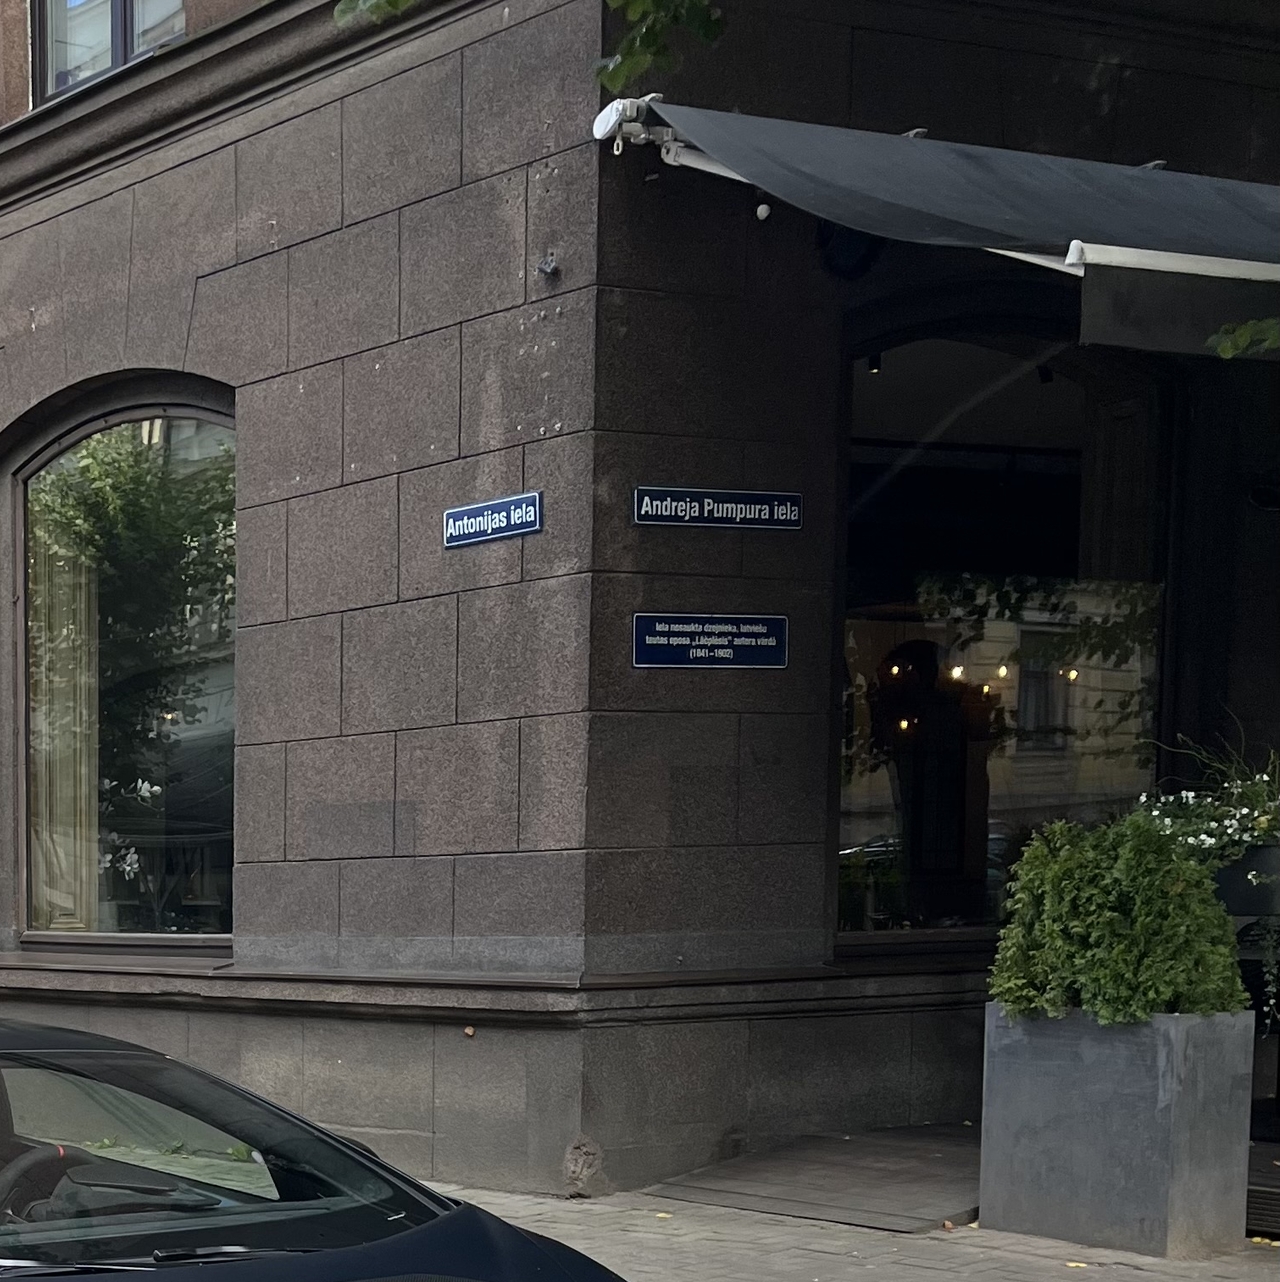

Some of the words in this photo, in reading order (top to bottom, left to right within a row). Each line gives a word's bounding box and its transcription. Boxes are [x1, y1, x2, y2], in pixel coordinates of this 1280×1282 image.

[447, 510, 507, 537] Antonijas
[510, 503, 535, 525] iela
[640, 496, 699, 520] Andreja
[703, 499, 769, 522] Pumpura
[773, 502, 799, 520] iela
